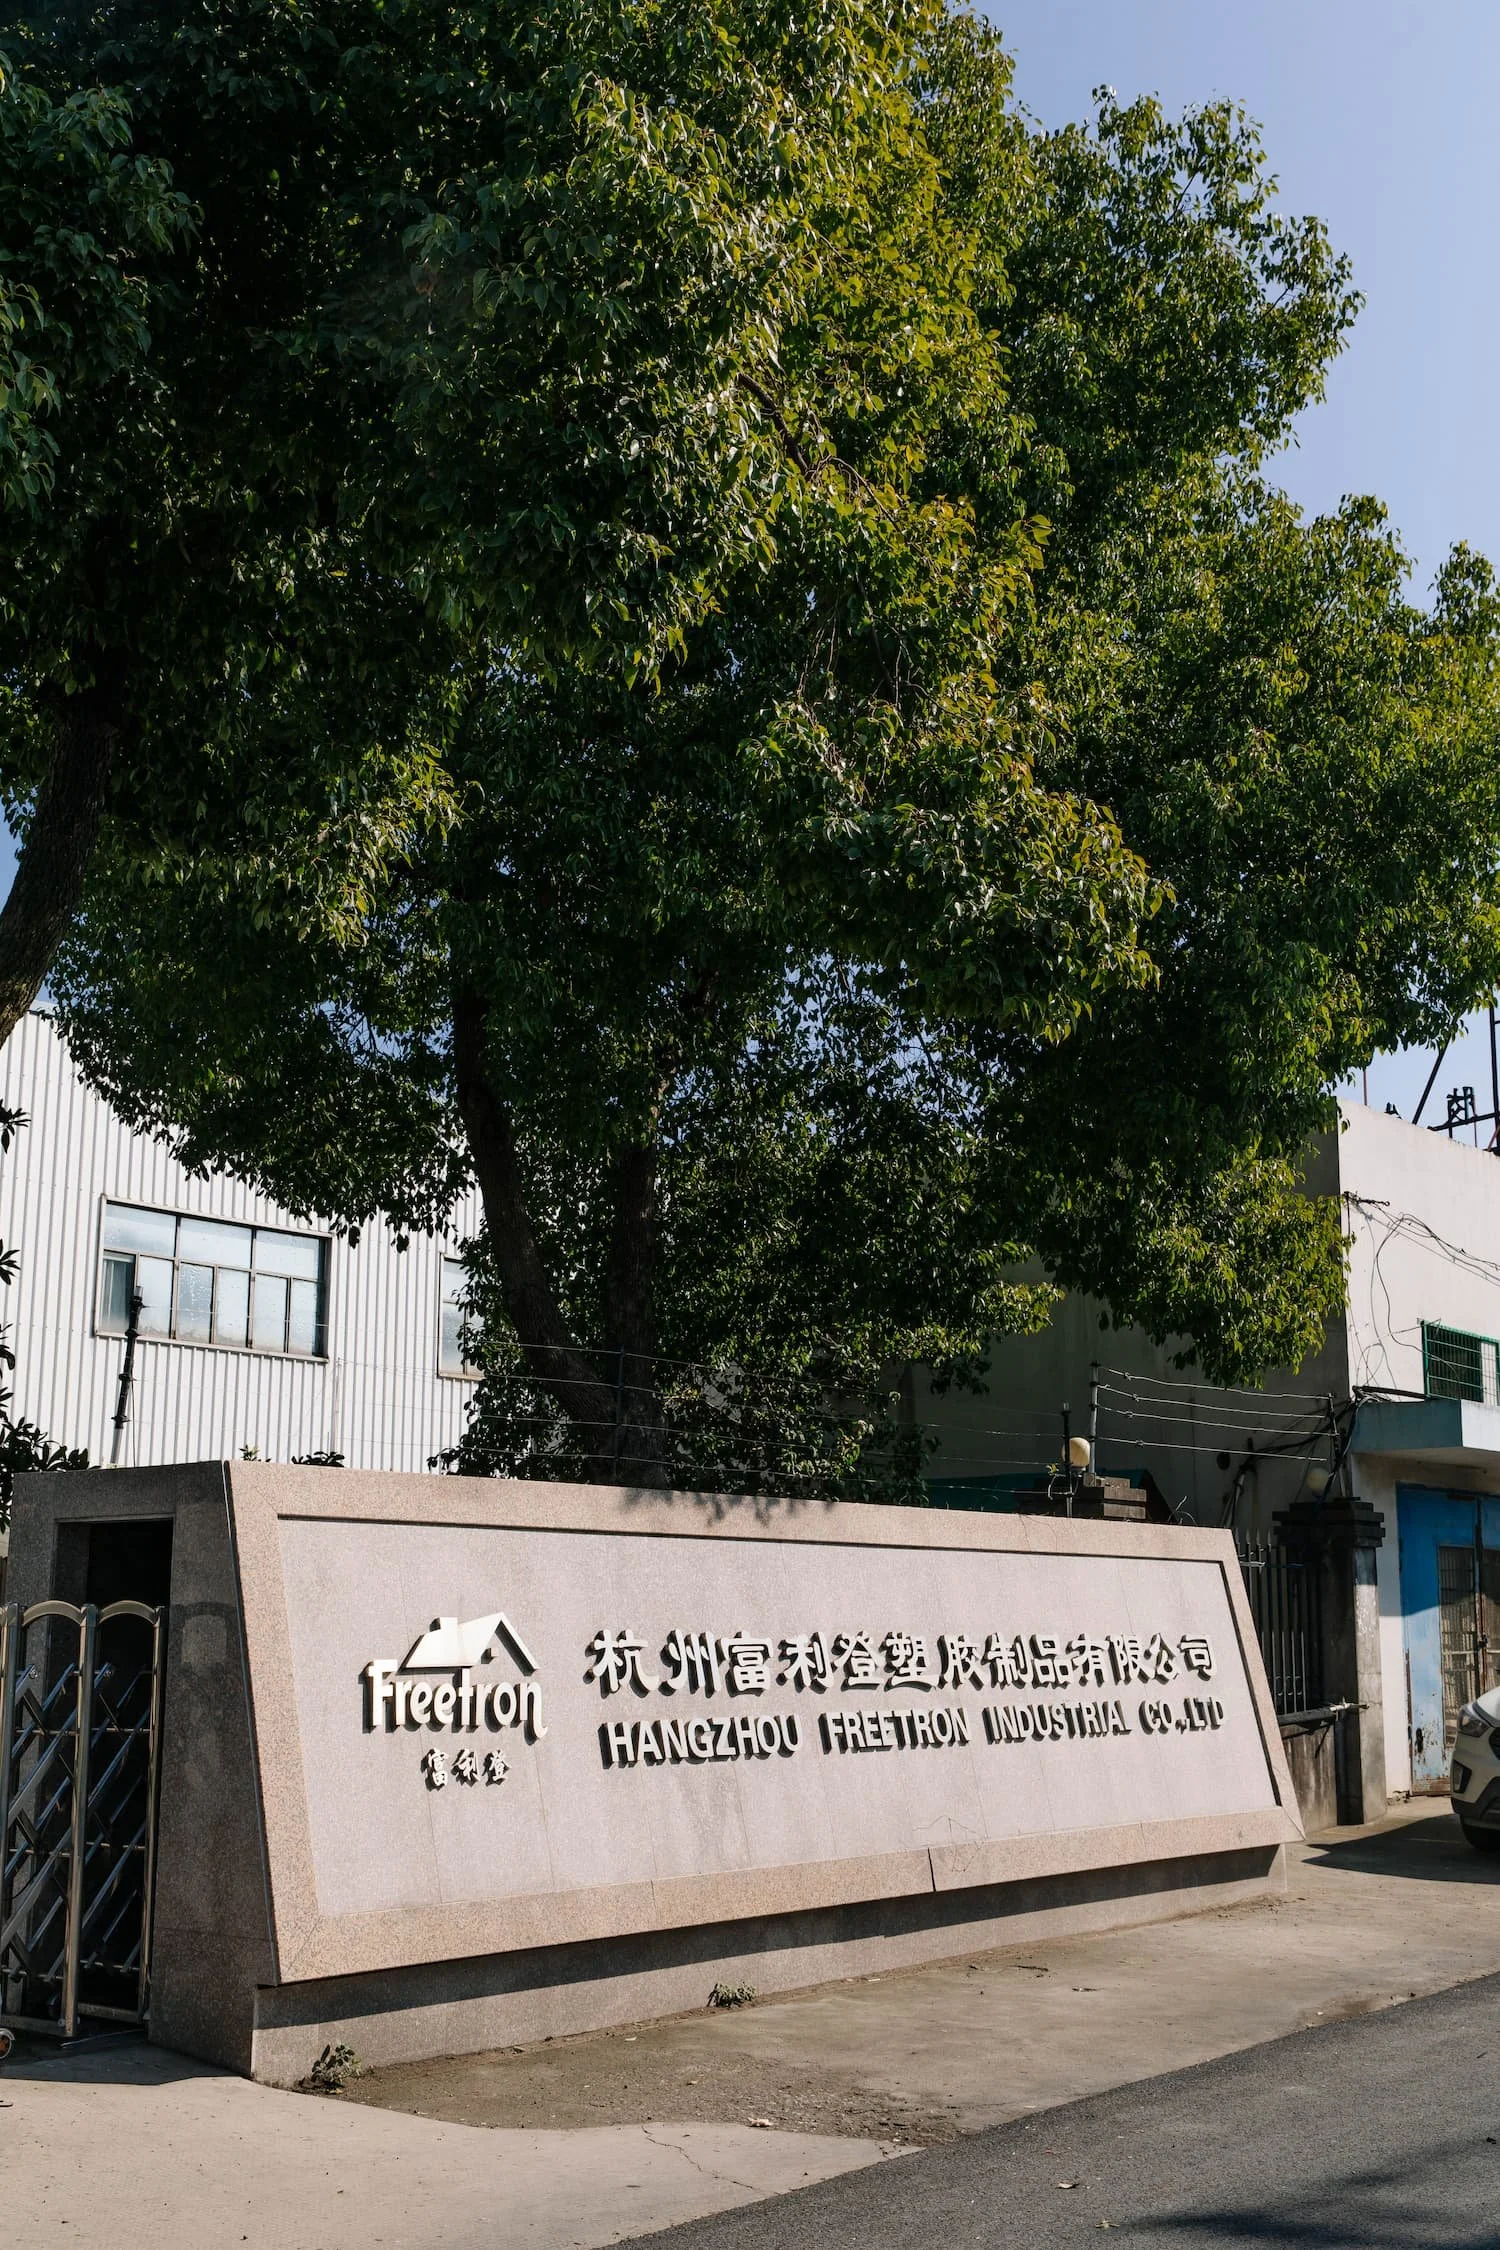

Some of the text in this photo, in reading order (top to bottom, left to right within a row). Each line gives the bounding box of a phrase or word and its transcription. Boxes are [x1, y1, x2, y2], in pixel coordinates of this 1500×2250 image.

[586, 1629, 1217, 1696] 杭州富利登塑胶制品有限公司
[360, 1659, 548, 1742] Freetron
[600, 1714, 803, 1767] HANGZHOU
[820, 1706, 971, 1753] FREETRON
[983, 1700, 1132, 1744] INDUSTRIAL
[422, 1749, 511, 1789] 富利登
